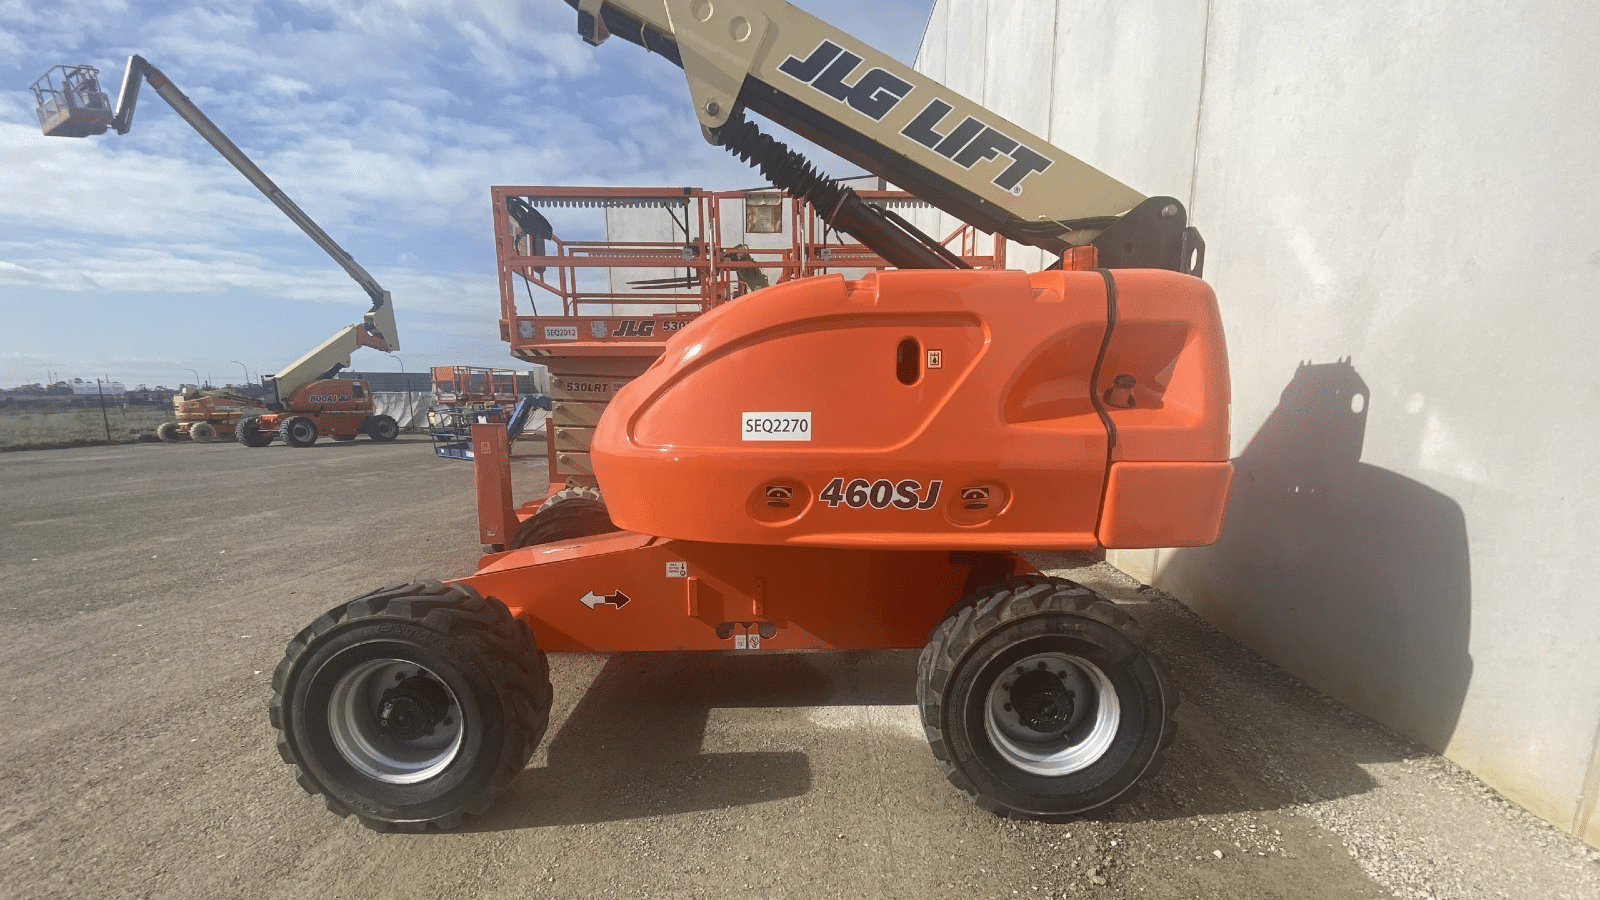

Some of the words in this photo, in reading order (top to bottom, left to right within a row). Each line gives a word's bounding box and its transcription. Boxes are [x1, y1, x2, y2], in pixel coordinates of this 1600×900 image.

[775, 38, 917, 124] JLG
[546, 329, 576, 338] SEQ2012
[611, 319, 656, 338] JLG
[662, 320, 691, 331] 530
[565, 382, 609, 393] 530LRT
[745, 418, 809, 434] SEQ2270
[818, 477, 943, 511] 460SJ
